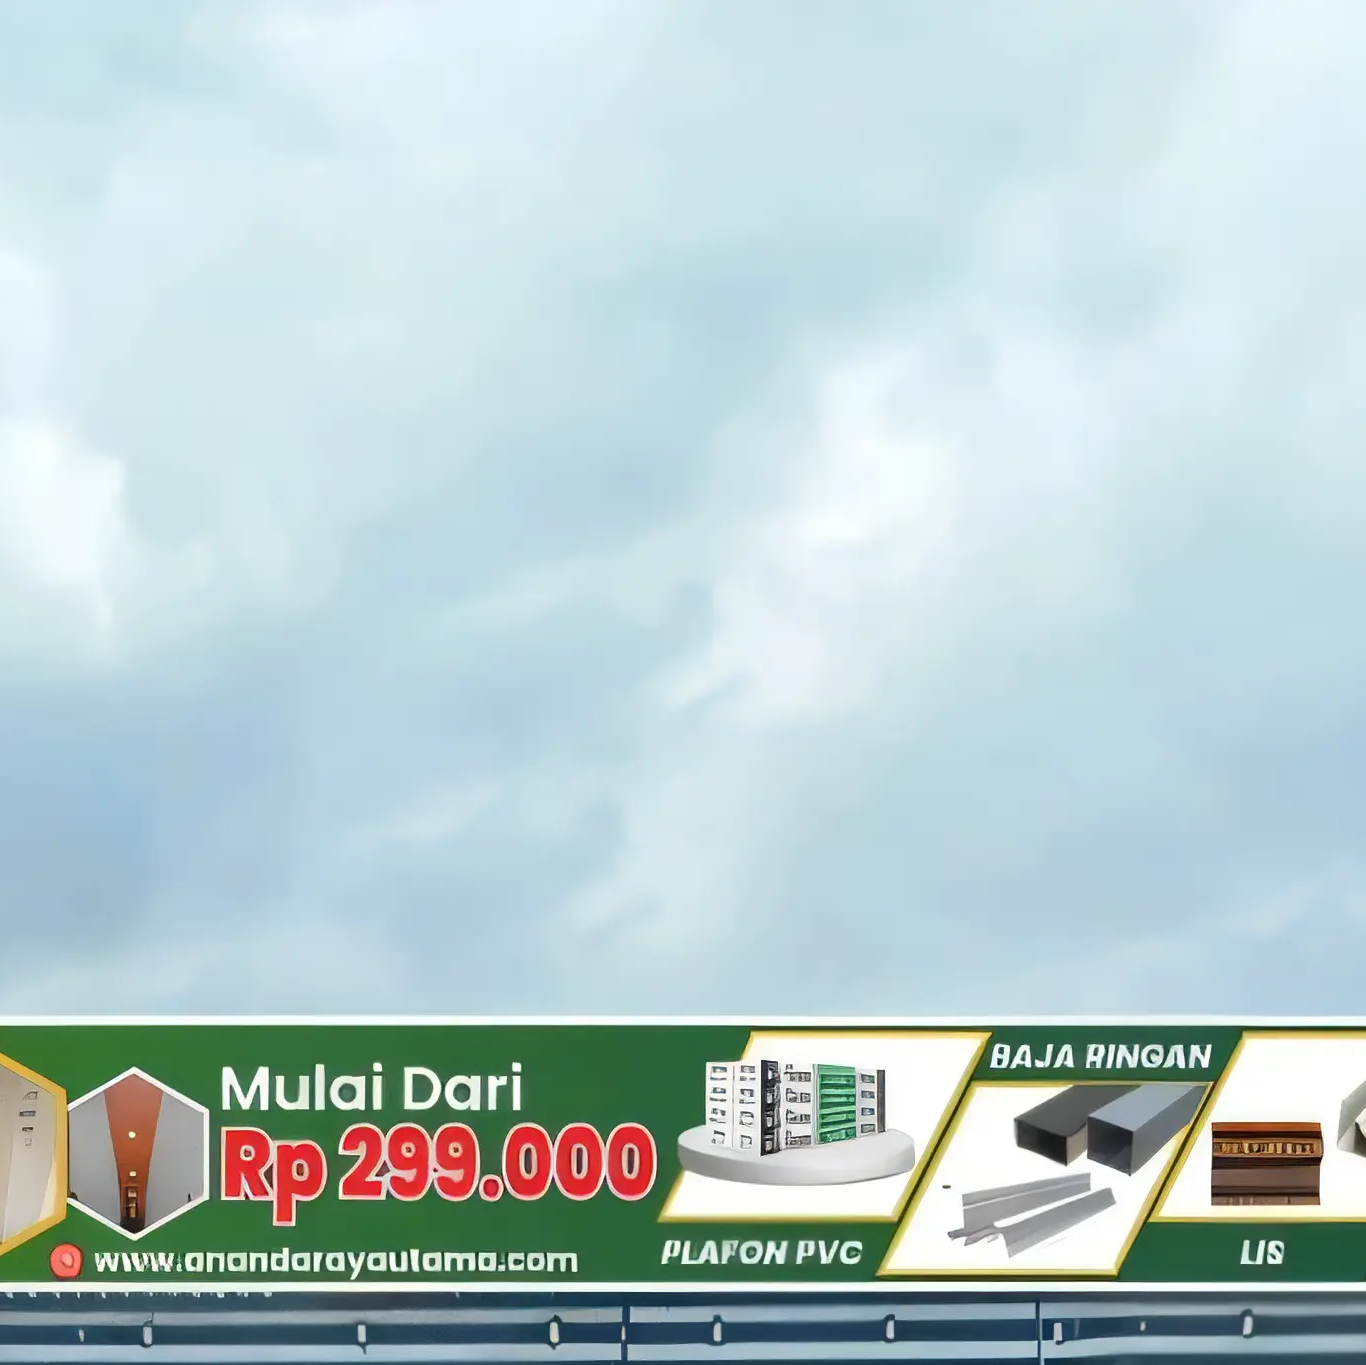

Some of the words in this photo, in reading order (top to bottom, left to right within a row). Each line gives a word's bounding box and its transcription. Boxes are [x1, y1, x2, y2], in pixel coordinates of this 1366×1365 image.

[990, 1043, 1076, 1070] BAJA
[222, 1062, 383, 1111] Mulai
[403, 1062, 522, 1111] Dari
[220, 1125, 327, 1227] Rp
[338, 1122, 658, 1202] 299.000
[661, 1240, 787, 1266] PLAFON
[796, 1240, 863, 1266] PVC
[1240, 1240, 1285, 1266] LIS
